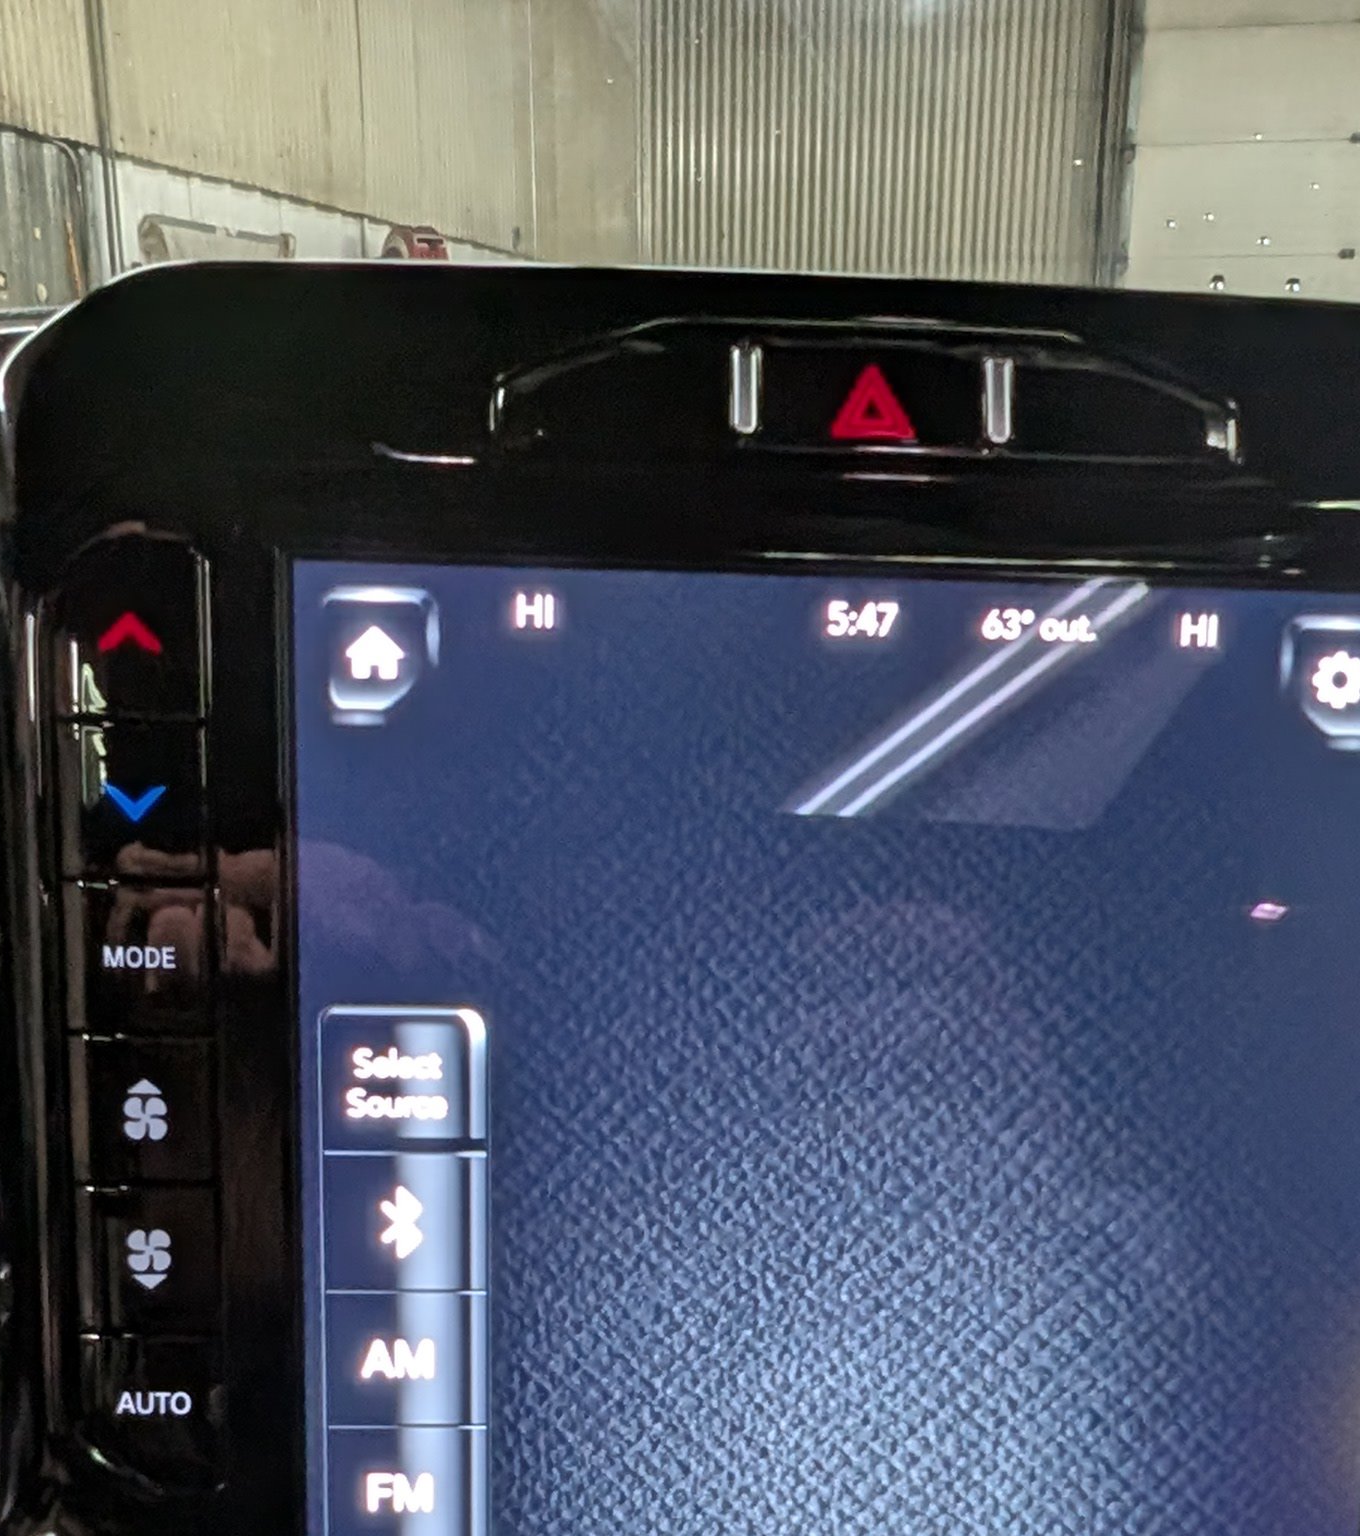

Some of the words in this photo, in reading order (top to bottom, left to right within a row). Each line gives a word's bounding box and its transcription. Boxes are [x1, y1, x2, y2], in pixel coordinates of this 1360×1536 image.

[513, 592, 556, 631] HI
[825, 600, 900, 638] 5:47
[981, 608, 1035, 642] 63°
[1178, 613, 1219, 649] HI
[102, 945, 178, 970] MODE
[352, 1047, 444, 1080] Select
[361, 1338, 436, 1380] AM
[115, 1391, 193, 1417] AUTO
[366, 1472, 435, 1514] FM
